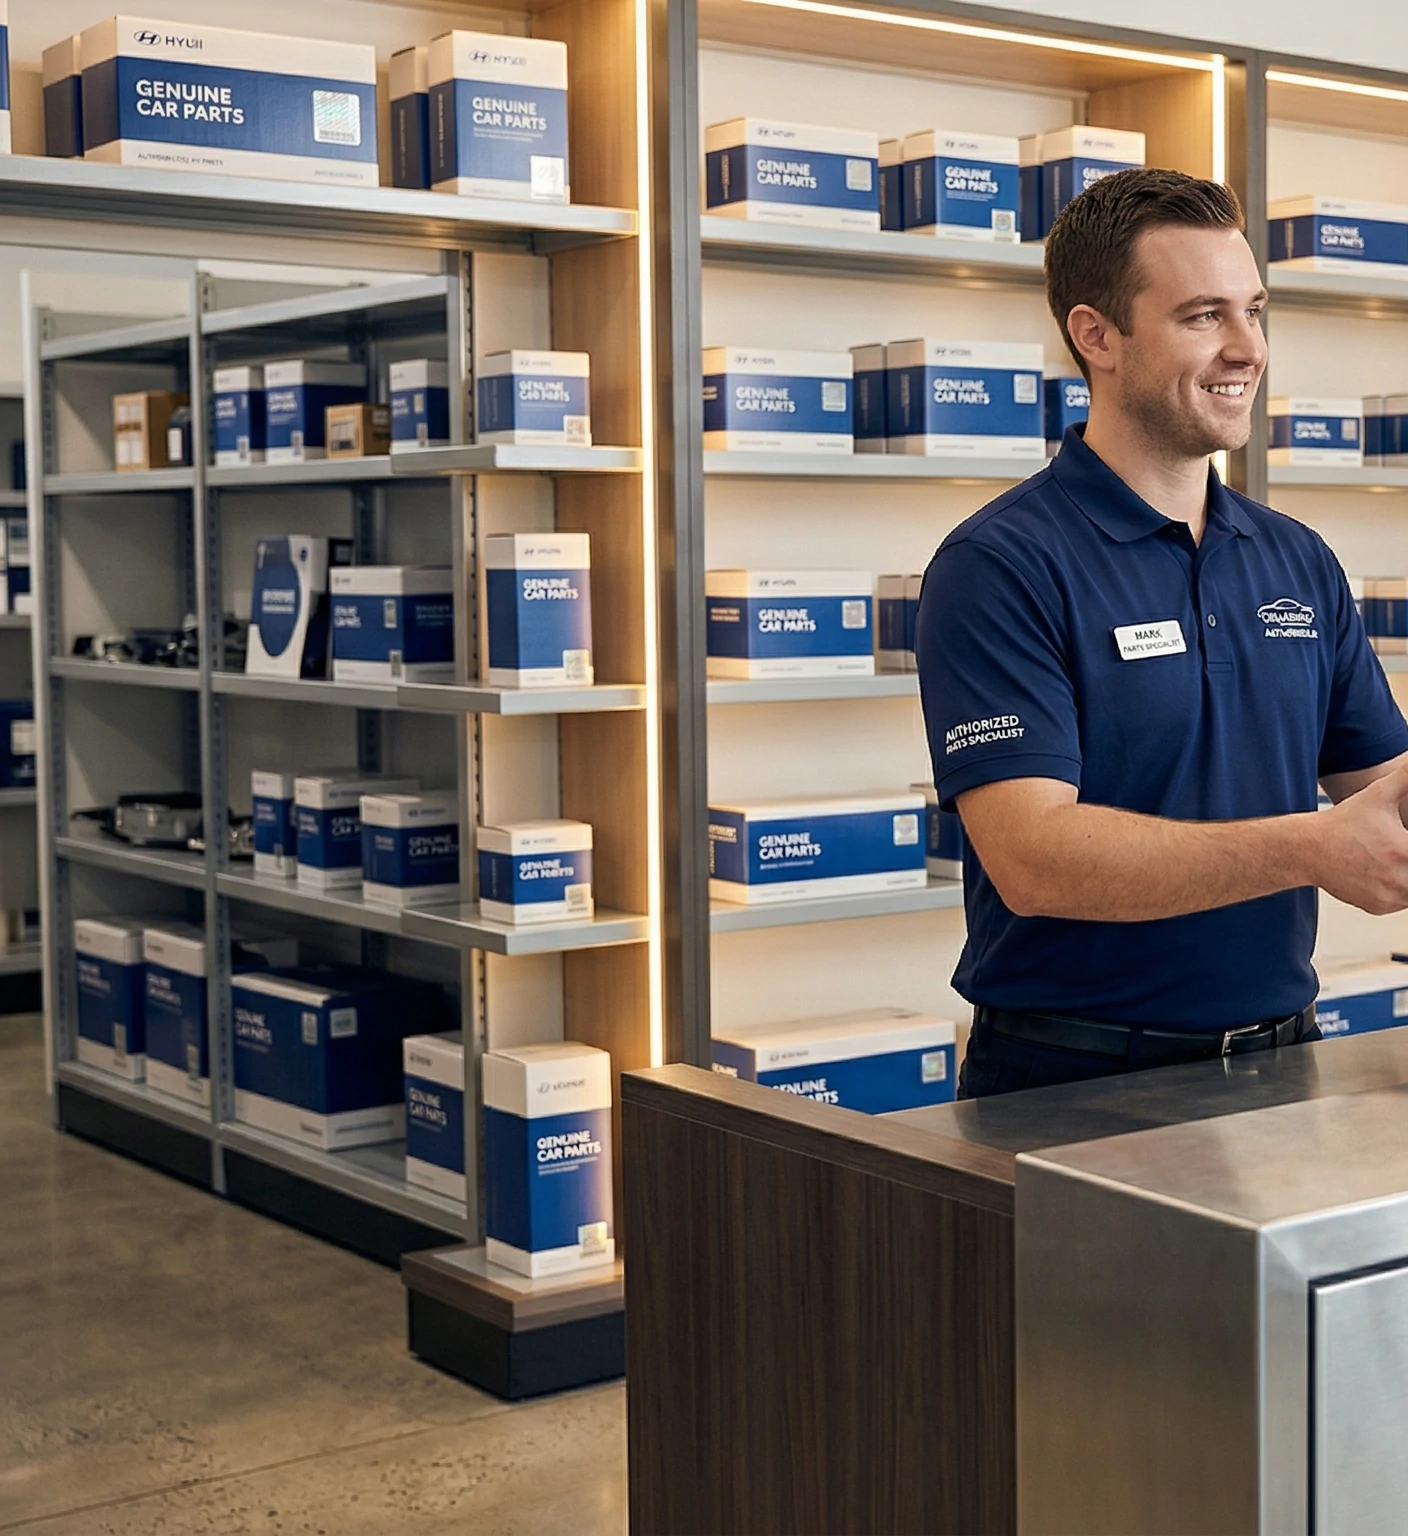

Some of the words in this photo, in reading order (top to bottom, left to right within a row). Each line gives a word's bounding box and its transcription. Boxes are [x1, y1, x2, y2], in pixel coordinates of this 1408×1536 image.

[136, 79, 231, 105] GENUINE
[136, 98, 179, 118] CAR
[183, 103, 244, 124] PARTS
[472, 97, 536, 115] GENUINE
[473, 111, 502, 126] CAR
[505, 115, 547, 130] PARTS
[757, 172, 782, 185] CAR
[783, 175, 817, 189] PARTS
[736, 385, 789, 400] GENUINE
[736, 399, 760, 412] CAR
[762, 400, 796, 414] PARTS
[759, 620, 782, 632] CAR
[759, 832, 810, 848] GENUINE
[759, 846, 784, 860] CAR
[785, 843, 822, 858] PARTS
[537, 1147, 563, 1162] CAR
[564, 1141, 601, 1158] PARTS
